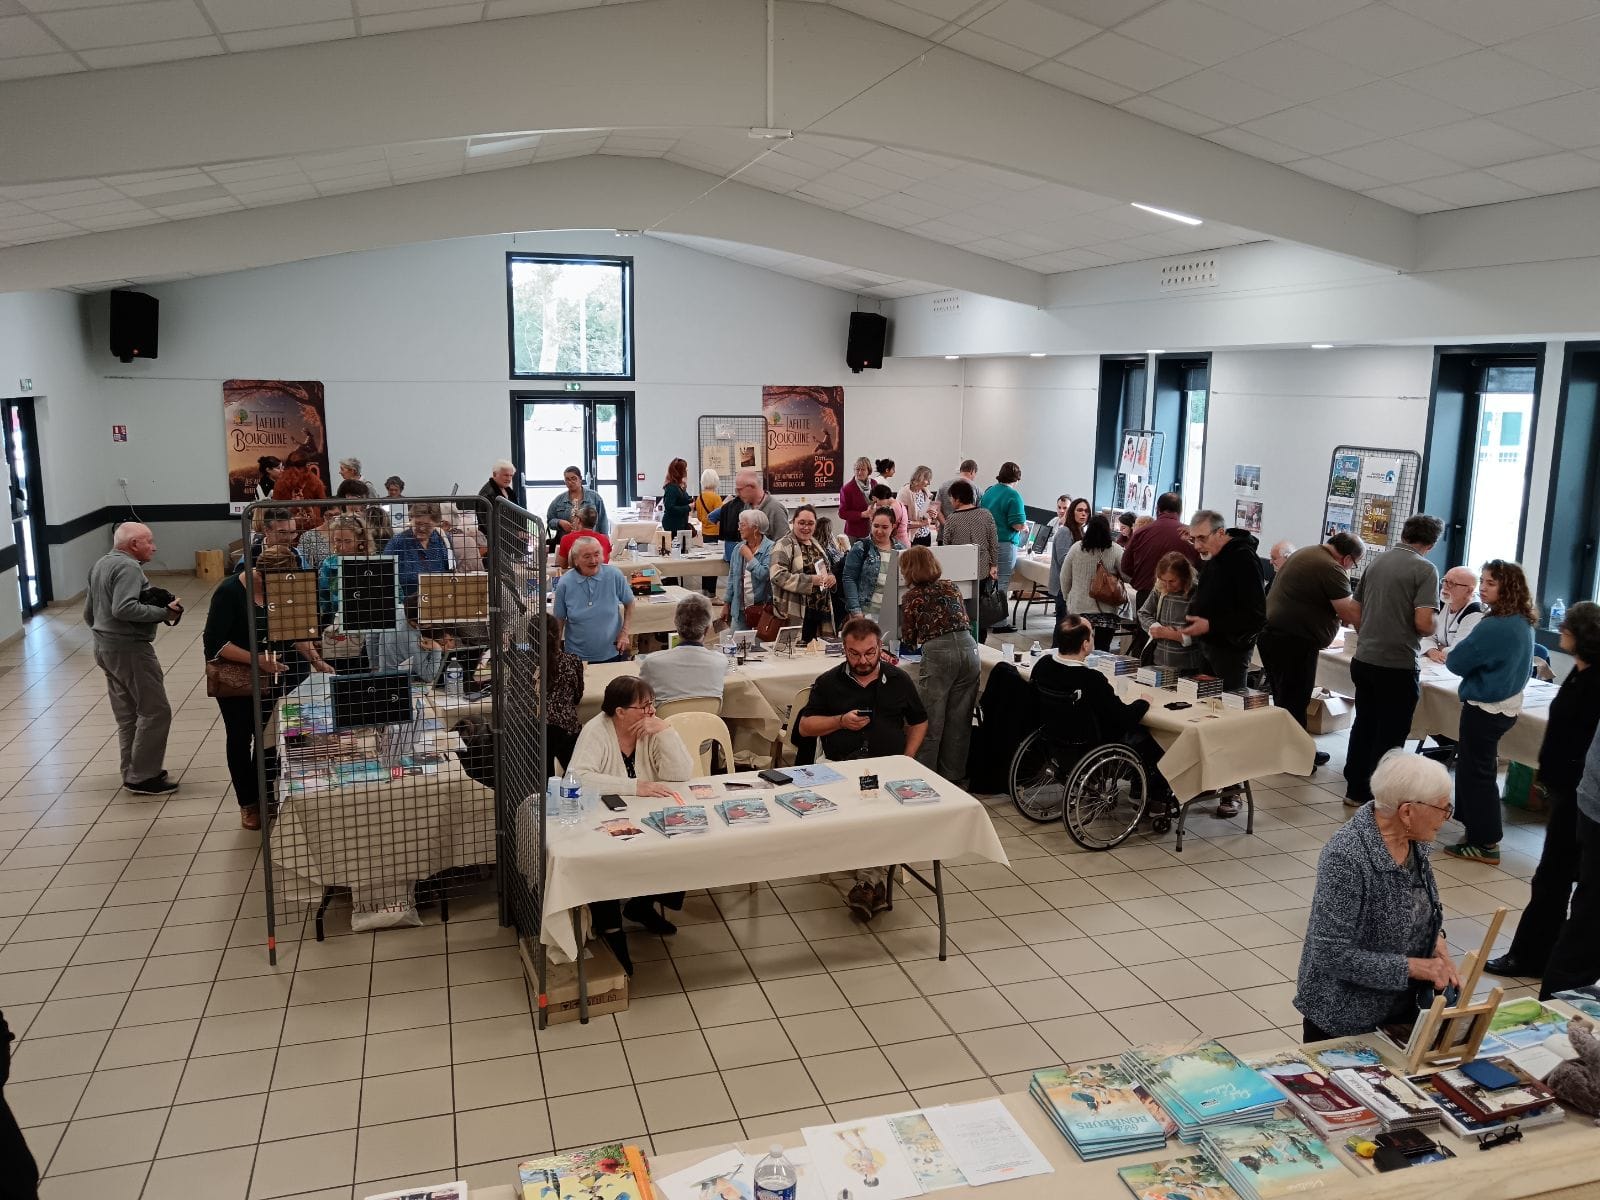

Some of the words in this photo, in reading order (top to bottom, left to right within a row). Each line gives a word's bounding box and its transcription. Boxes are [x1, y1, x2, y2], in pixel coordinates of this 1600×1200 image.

[230, 428, 288, 452] BOUQUINE
[767, 429, 811, 450] BOUQUINE
[814, 460, 835, 477] 20
[1076, 1115, 1148, 1130] BONHEURS
